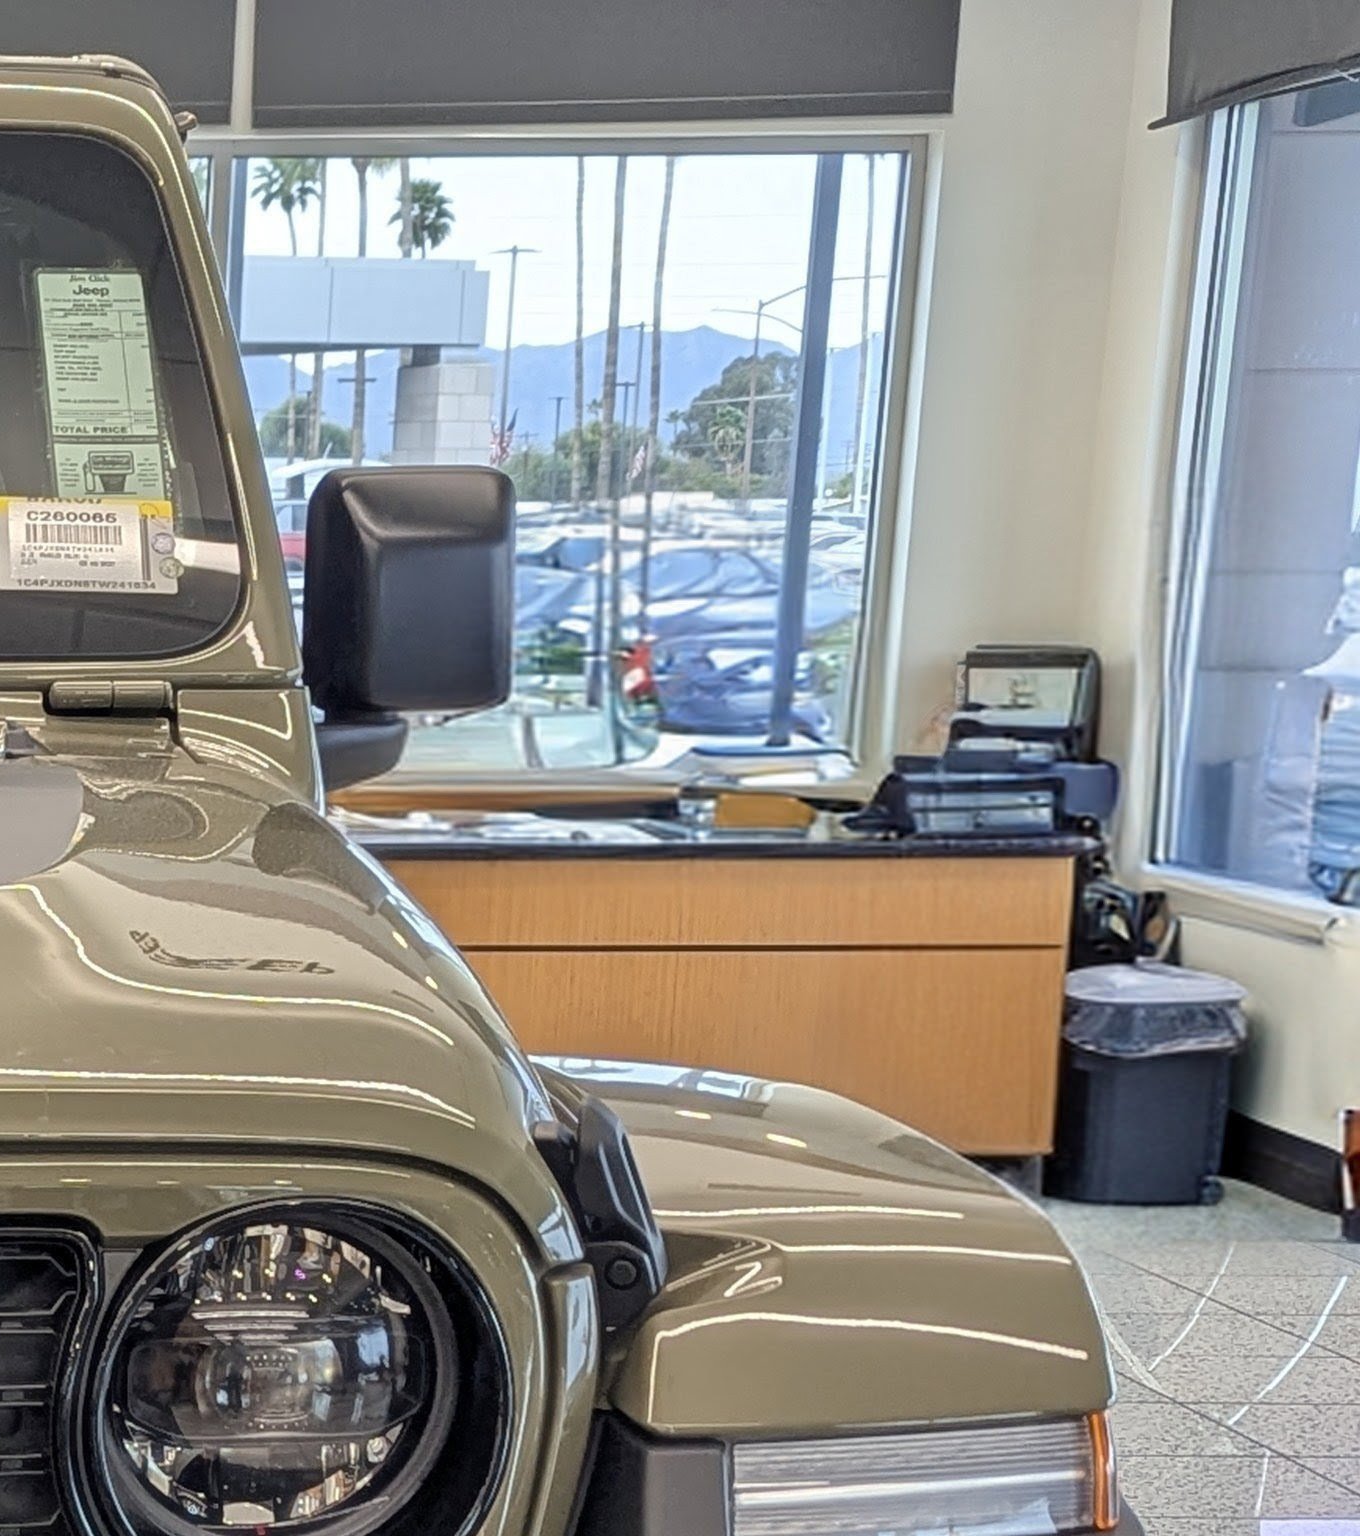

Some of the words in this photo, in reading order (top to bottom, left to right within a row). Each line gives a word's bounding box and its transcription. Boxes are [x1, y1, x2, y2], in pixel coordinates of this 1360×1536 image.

[72, 284, 110, 297] Jeep
[54, 425, 90, 434] TOTAL
[92, 425, 128, 434] PRICE
